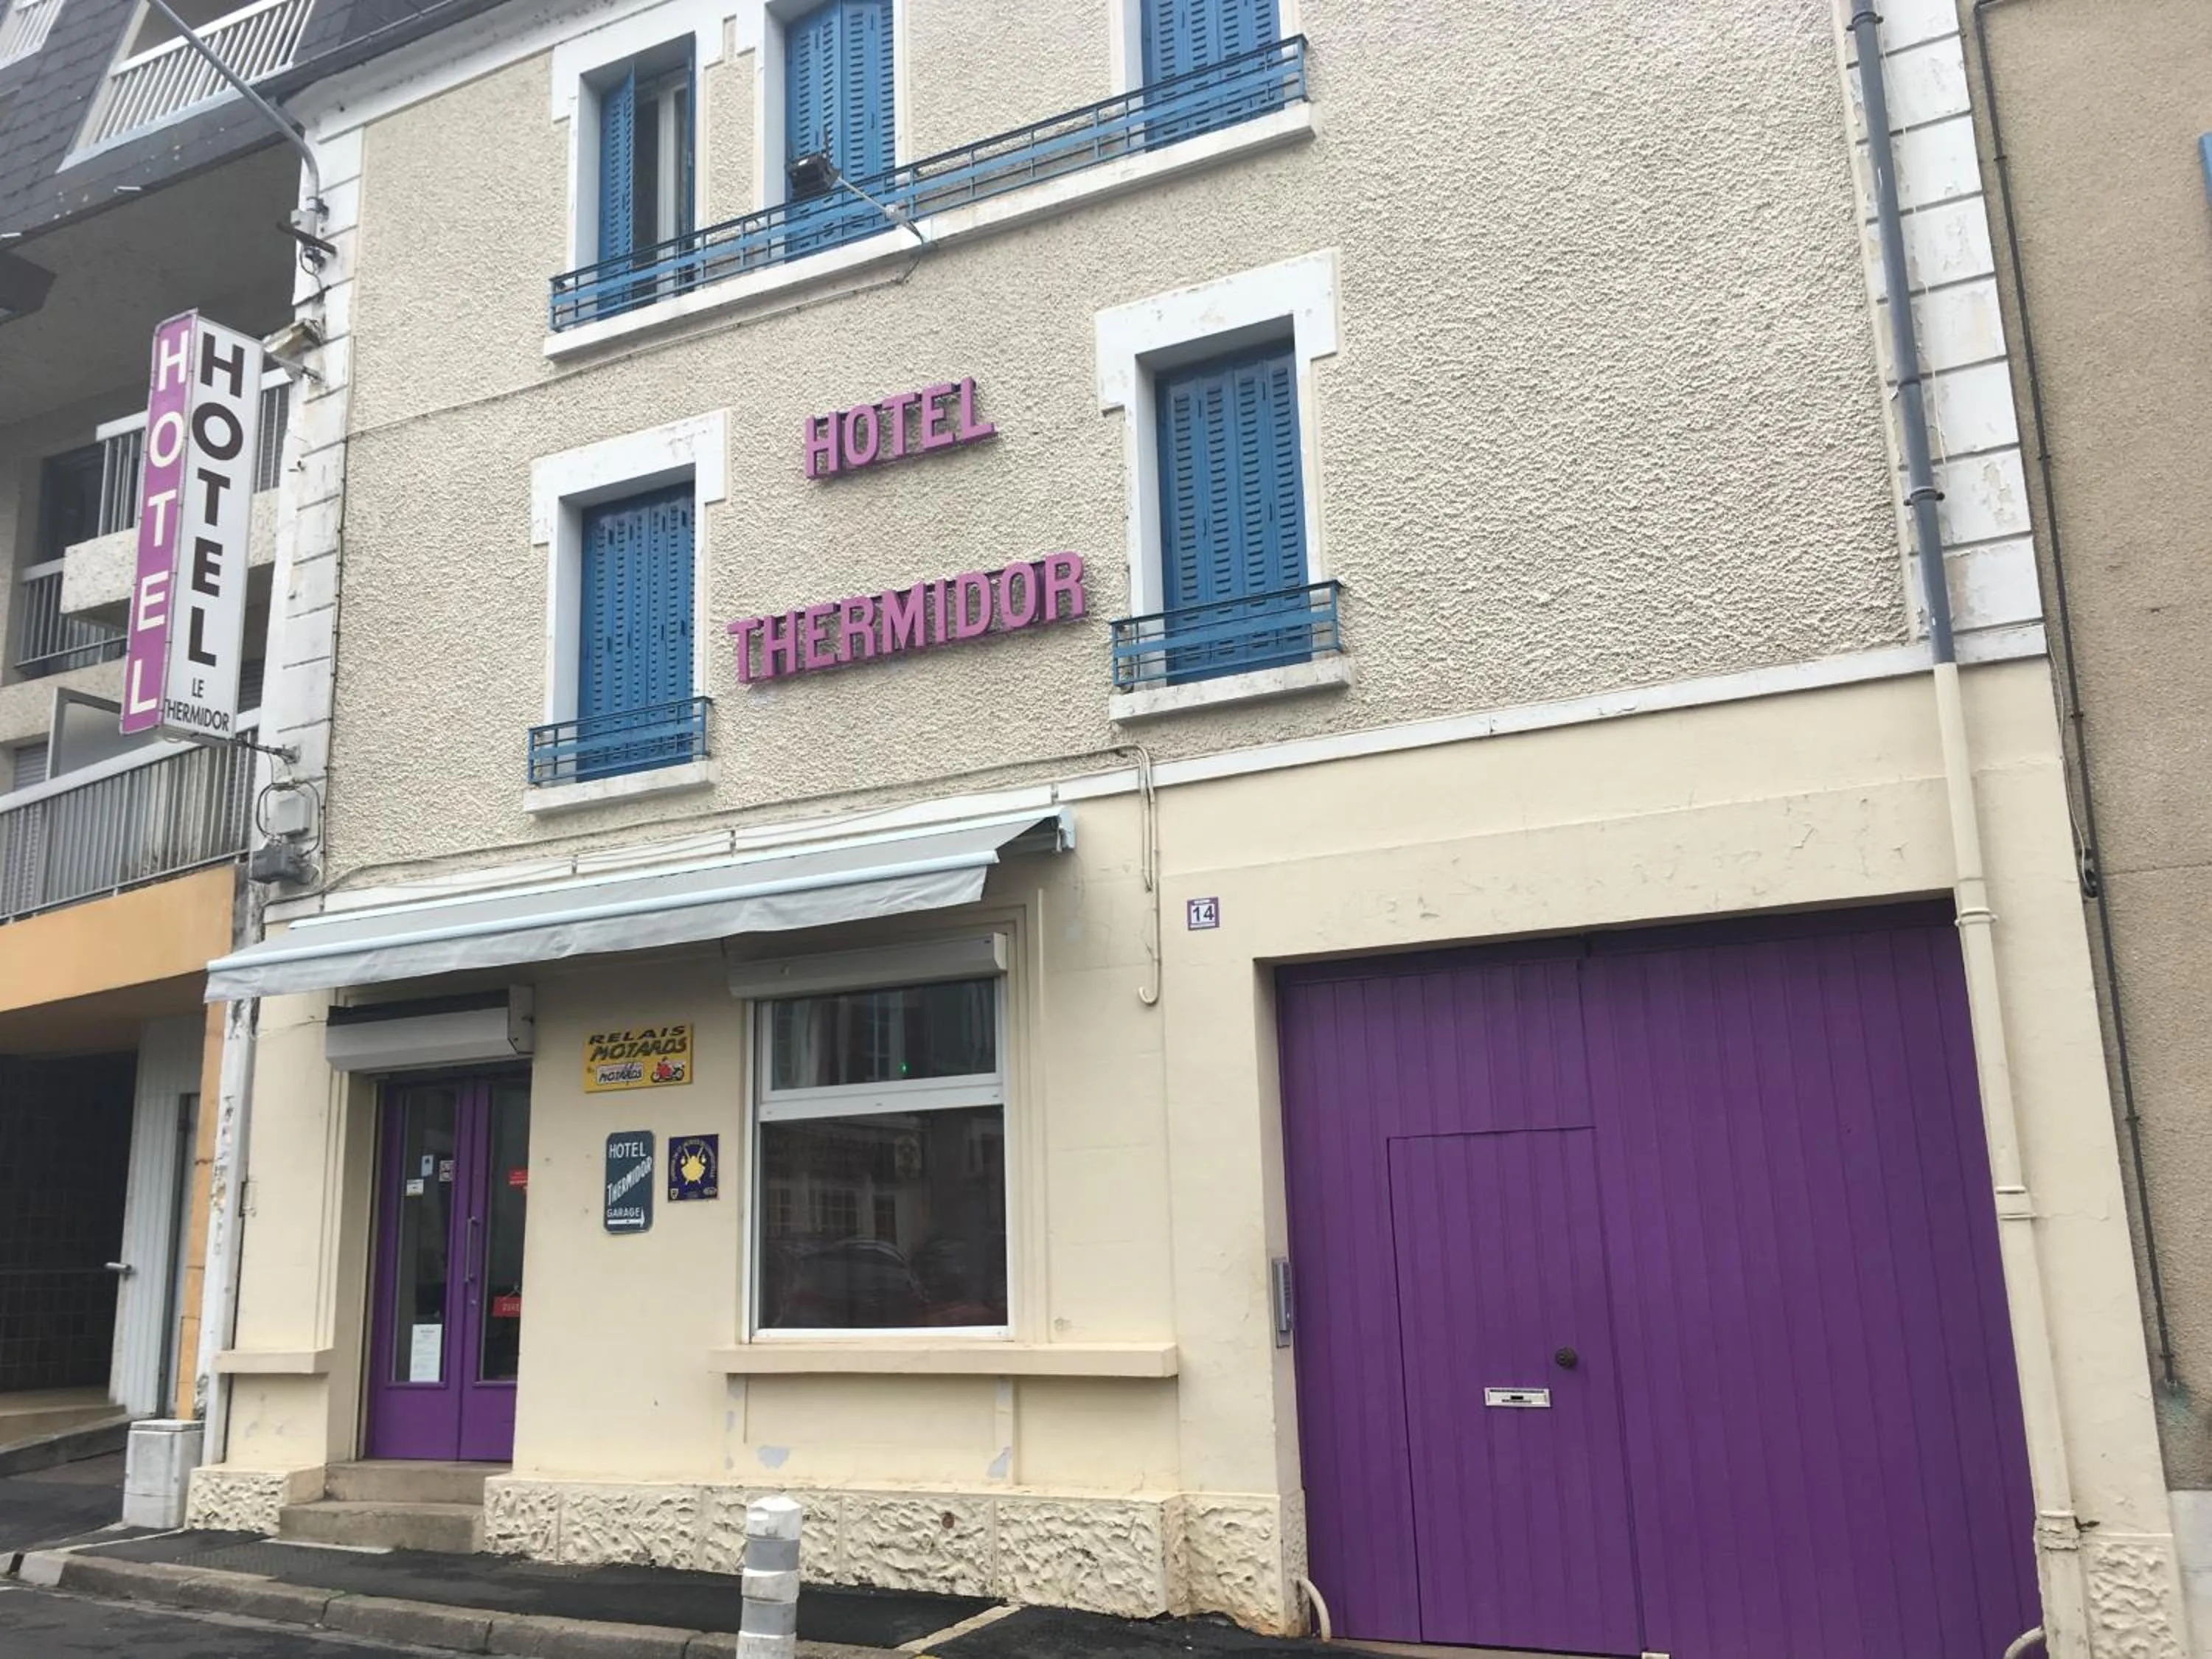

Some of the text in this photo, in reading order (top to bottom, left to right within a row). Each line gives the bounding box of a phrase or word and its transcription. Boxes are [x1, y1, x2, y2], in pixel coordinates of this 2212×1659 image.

[804, 377, 996, 479] HOTEL
[187, 332, 245, 667] HOTEL
[128, 330, 189, 714] HOTEL
[727, 552, 1086, 684] THERMIDOR
[192, 678, 204, 699] LE
[1192, 905, 1214, 922] 14
[589, 1026, 685, 1045] RELAIS
[590, 1037, 687, 1062] MOTARDS
[608, 1141, 646, 1158] HOTEL
[607, 1207, 641, 1217] GARAGE
